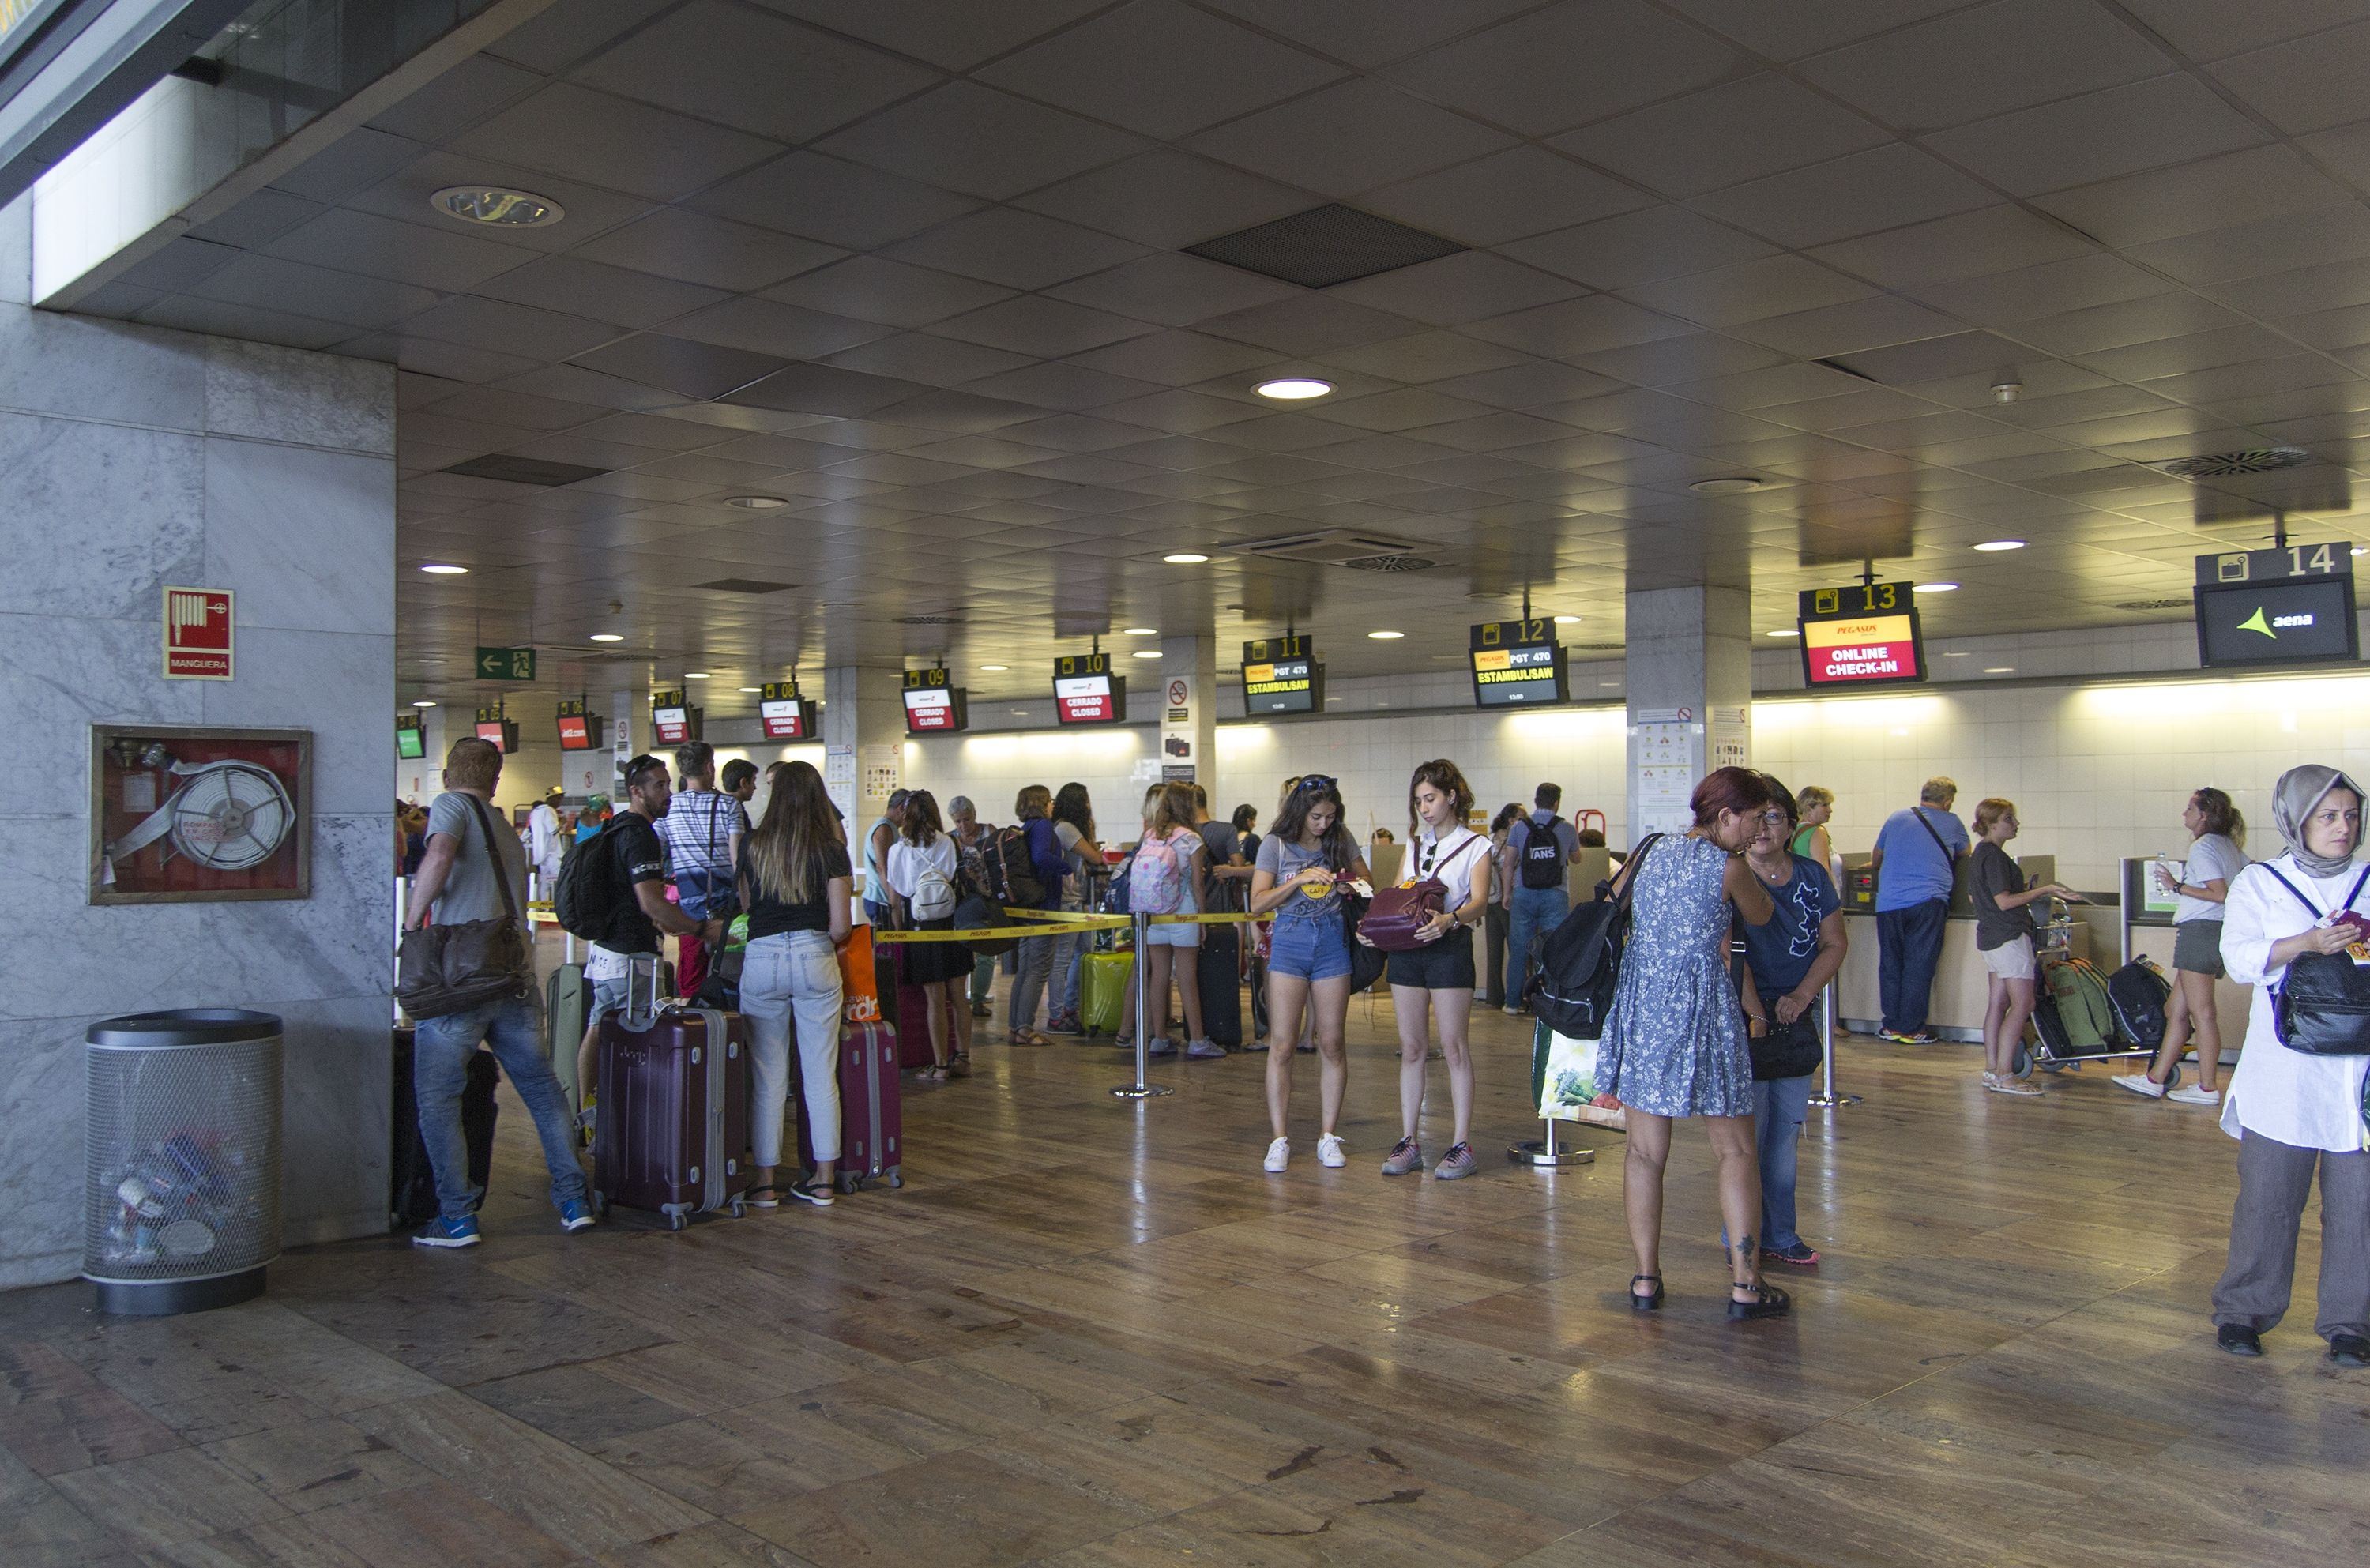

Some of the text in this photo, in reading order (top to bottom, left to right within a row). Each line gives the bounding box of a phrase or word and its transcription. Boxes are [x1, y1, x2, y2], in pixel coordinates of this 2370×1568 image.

[2287, 544, 2335, 577] 14
[1863, 584, 1897, 611] 13
[2273, 615, 2313, 627] aena
[1518, 619, 1544, 642] 12
[1837, 624, 1878, 634] PEGASUS
[1281, 637, 1301, 657] 11
[1510, 653, 1529, 664] PGT
[1533, 652, 1551, 662] 470
[1831, 647, 1888, 661] ONLINE
[171, 659, 228, 669] MANGUERA
[1085, 655, 1104, 673] 10
[1274, 667, 1290, 676] PGT
[1292, 665, 1307, 675] 470
[1826, 660, 1898, 676] CHECK-IN
[928, 669, 945, 686] 09
[1477, 667, 1553, 683] ESTAMBUL/SAW
[1247, 679, 1310, 694] ESTAMBUL/SAW
[1066, 697, 1103, 707] CERRADO
[915, 708, 945, 716] CERRADO
[1071, 708, 1101, 717] CLOSED
[919, 717, 944, 726] CLOSED
[1529, 846, 1556, 859] VANS
